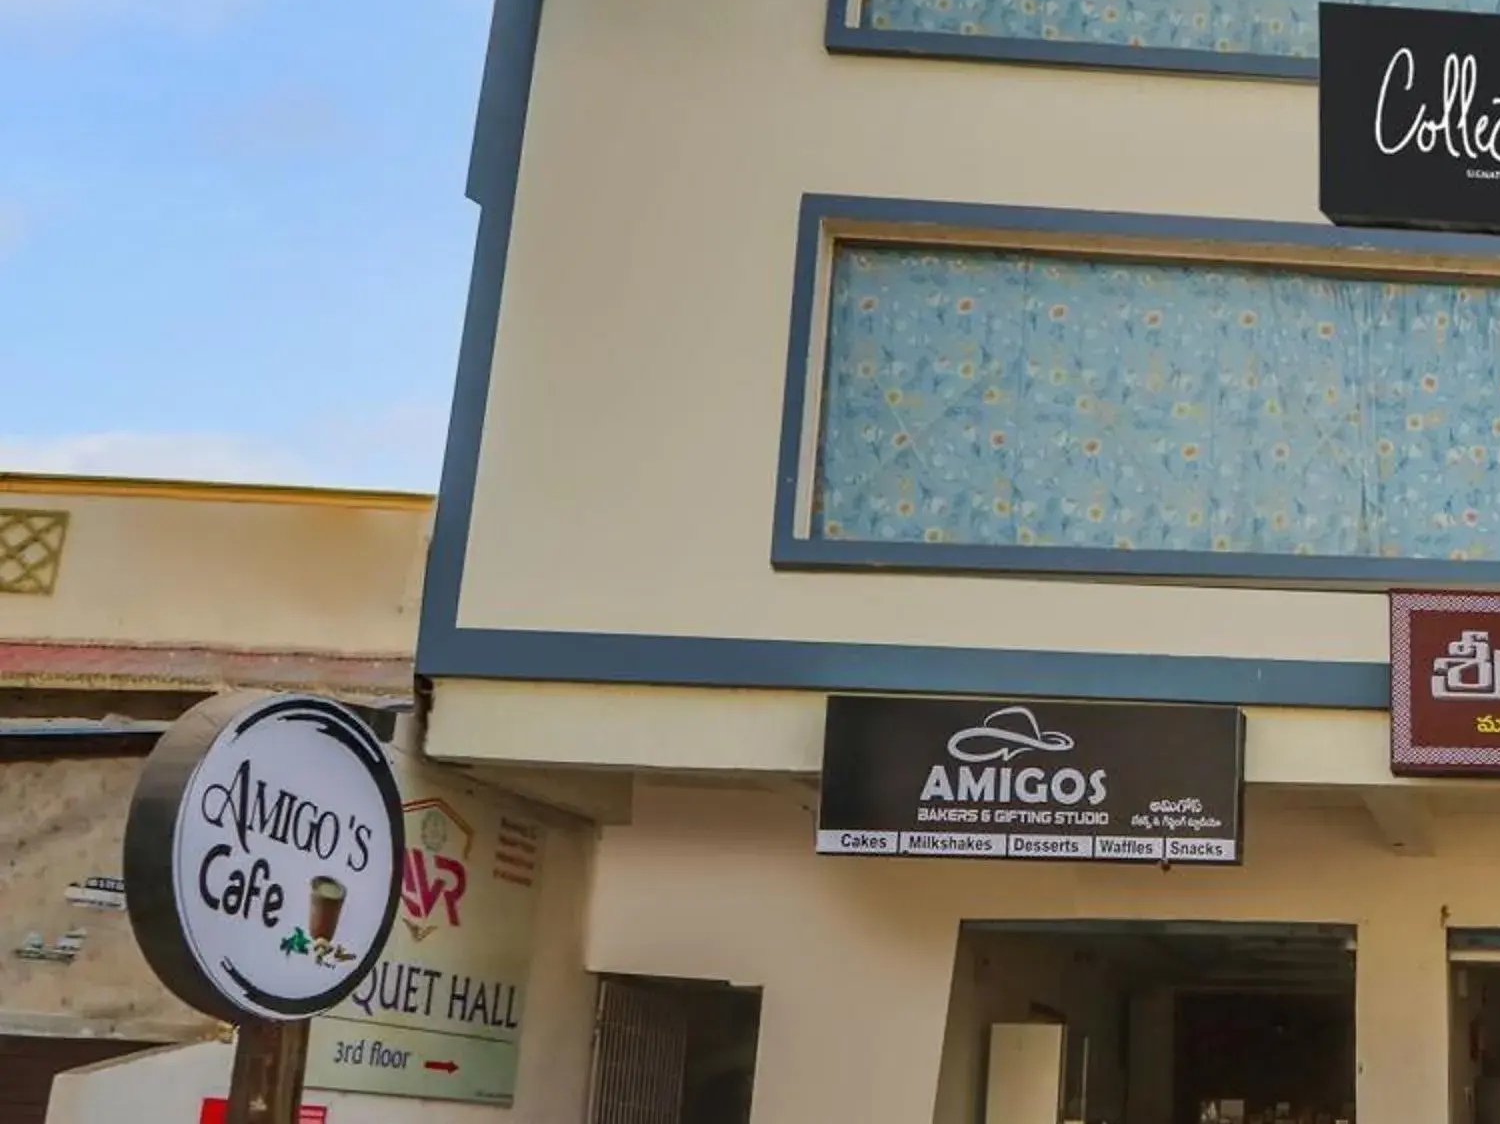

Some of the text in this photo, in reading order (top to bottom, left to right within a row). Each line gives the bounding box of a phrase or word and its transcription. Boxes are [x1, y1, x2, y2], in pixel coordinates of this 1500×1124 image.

[919, 764, 1107, 805] AMIGOS
[202, 759, 373, 872] AMIGO'S
[918, 807, 1110, 826] BAKERS & GIFTING STUDIO
[840, 833, 888, 850] Cakes
[908, 835, 994, 852] Milkshakes
[1013, 838, 1080, 854] Desserts
[1100, 839, 1154, 856] Waffles
[1169, 840, 1224, 857] Snacks
[199, 844, 285, 928] Cafe
[352, 961, 519, 1029] QUET HALL
[333, 1039, 413, 1070] 3rd floor
